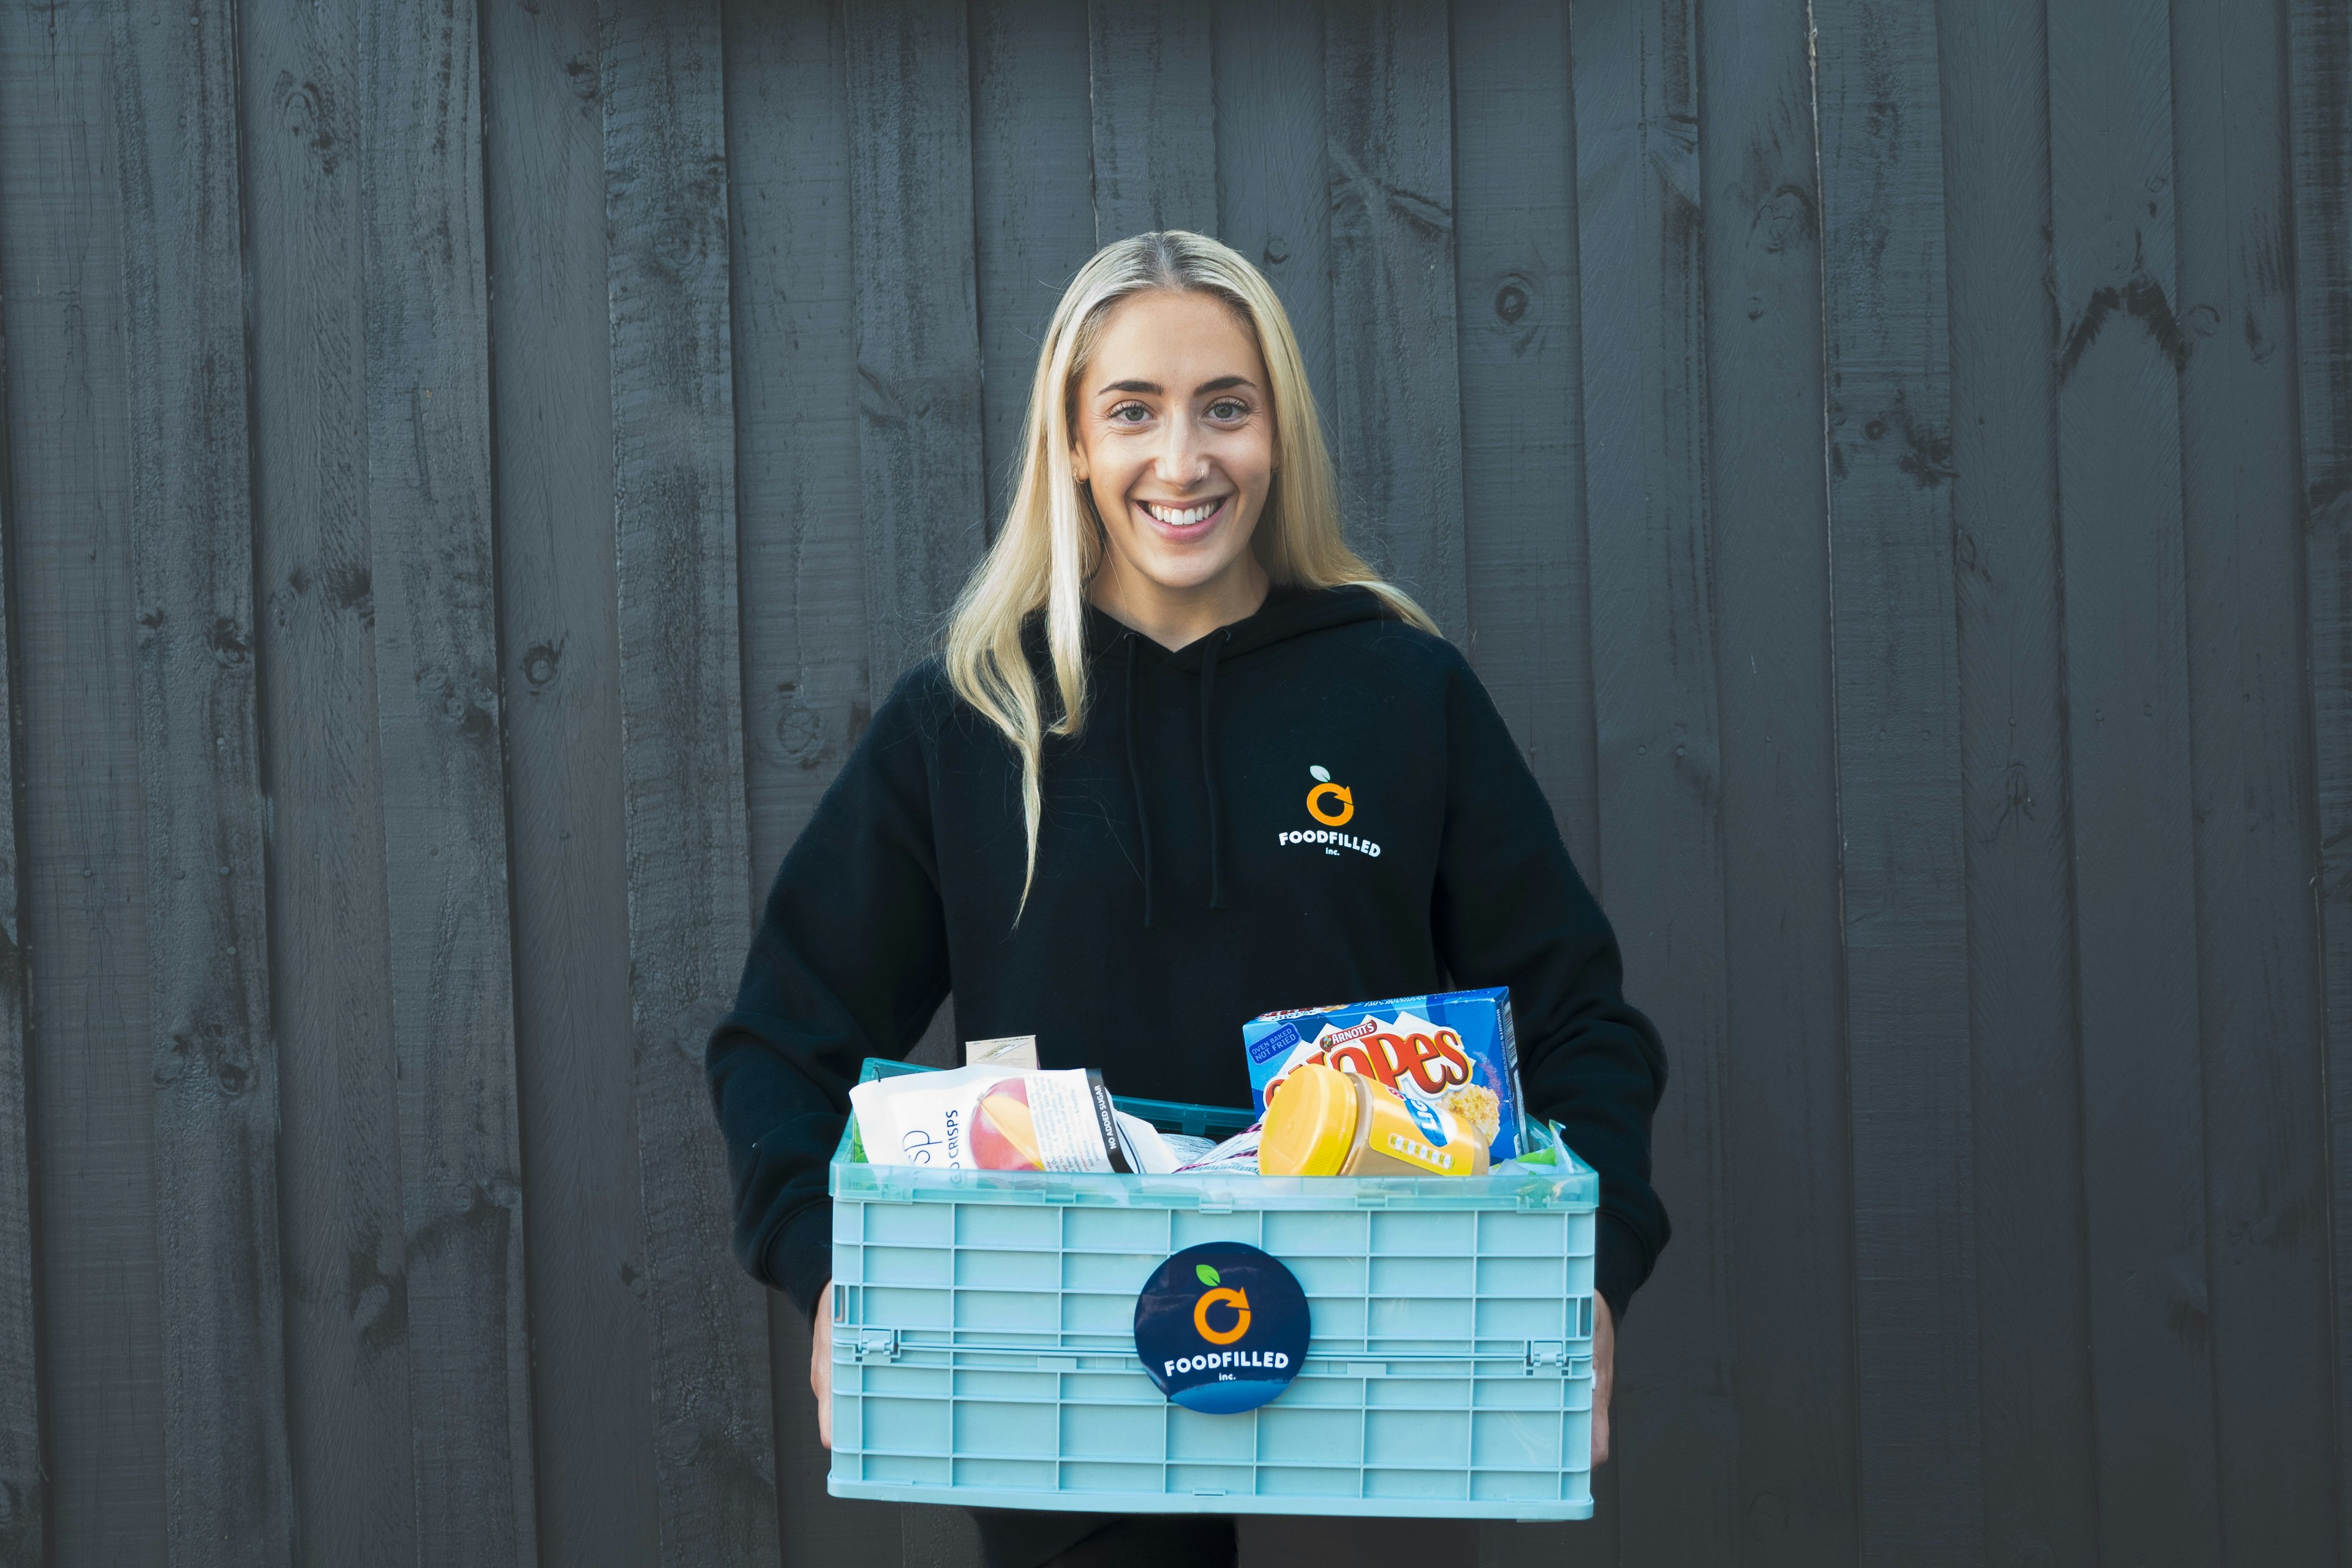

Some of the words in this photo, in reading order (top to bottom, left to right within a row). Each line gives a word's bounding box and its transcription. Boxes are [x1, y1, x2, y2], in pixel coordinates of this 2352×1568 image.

[1278, 830, 1381, 858] FOODFILLED
[1251, 1041, 1270, 1055] OVEN
[1269, 1028, 1292, 1044] BAKED
[1331, 1022, 1374, 1045] ARNOTT'S
[1254, 1048, 1271, 1061] NOT
[1272, 1033, 1297, 1052] FRIED
[1093, 1084, 1107, 1110] SUGAR
[946, 1109, 959, 1158] CRISPS
[1101, 1110, 1114, 1136] ADDED
[1108, 1137, 1117, 1150] NO
[1164, 1351, 1289, 1377] FOODFILLED
